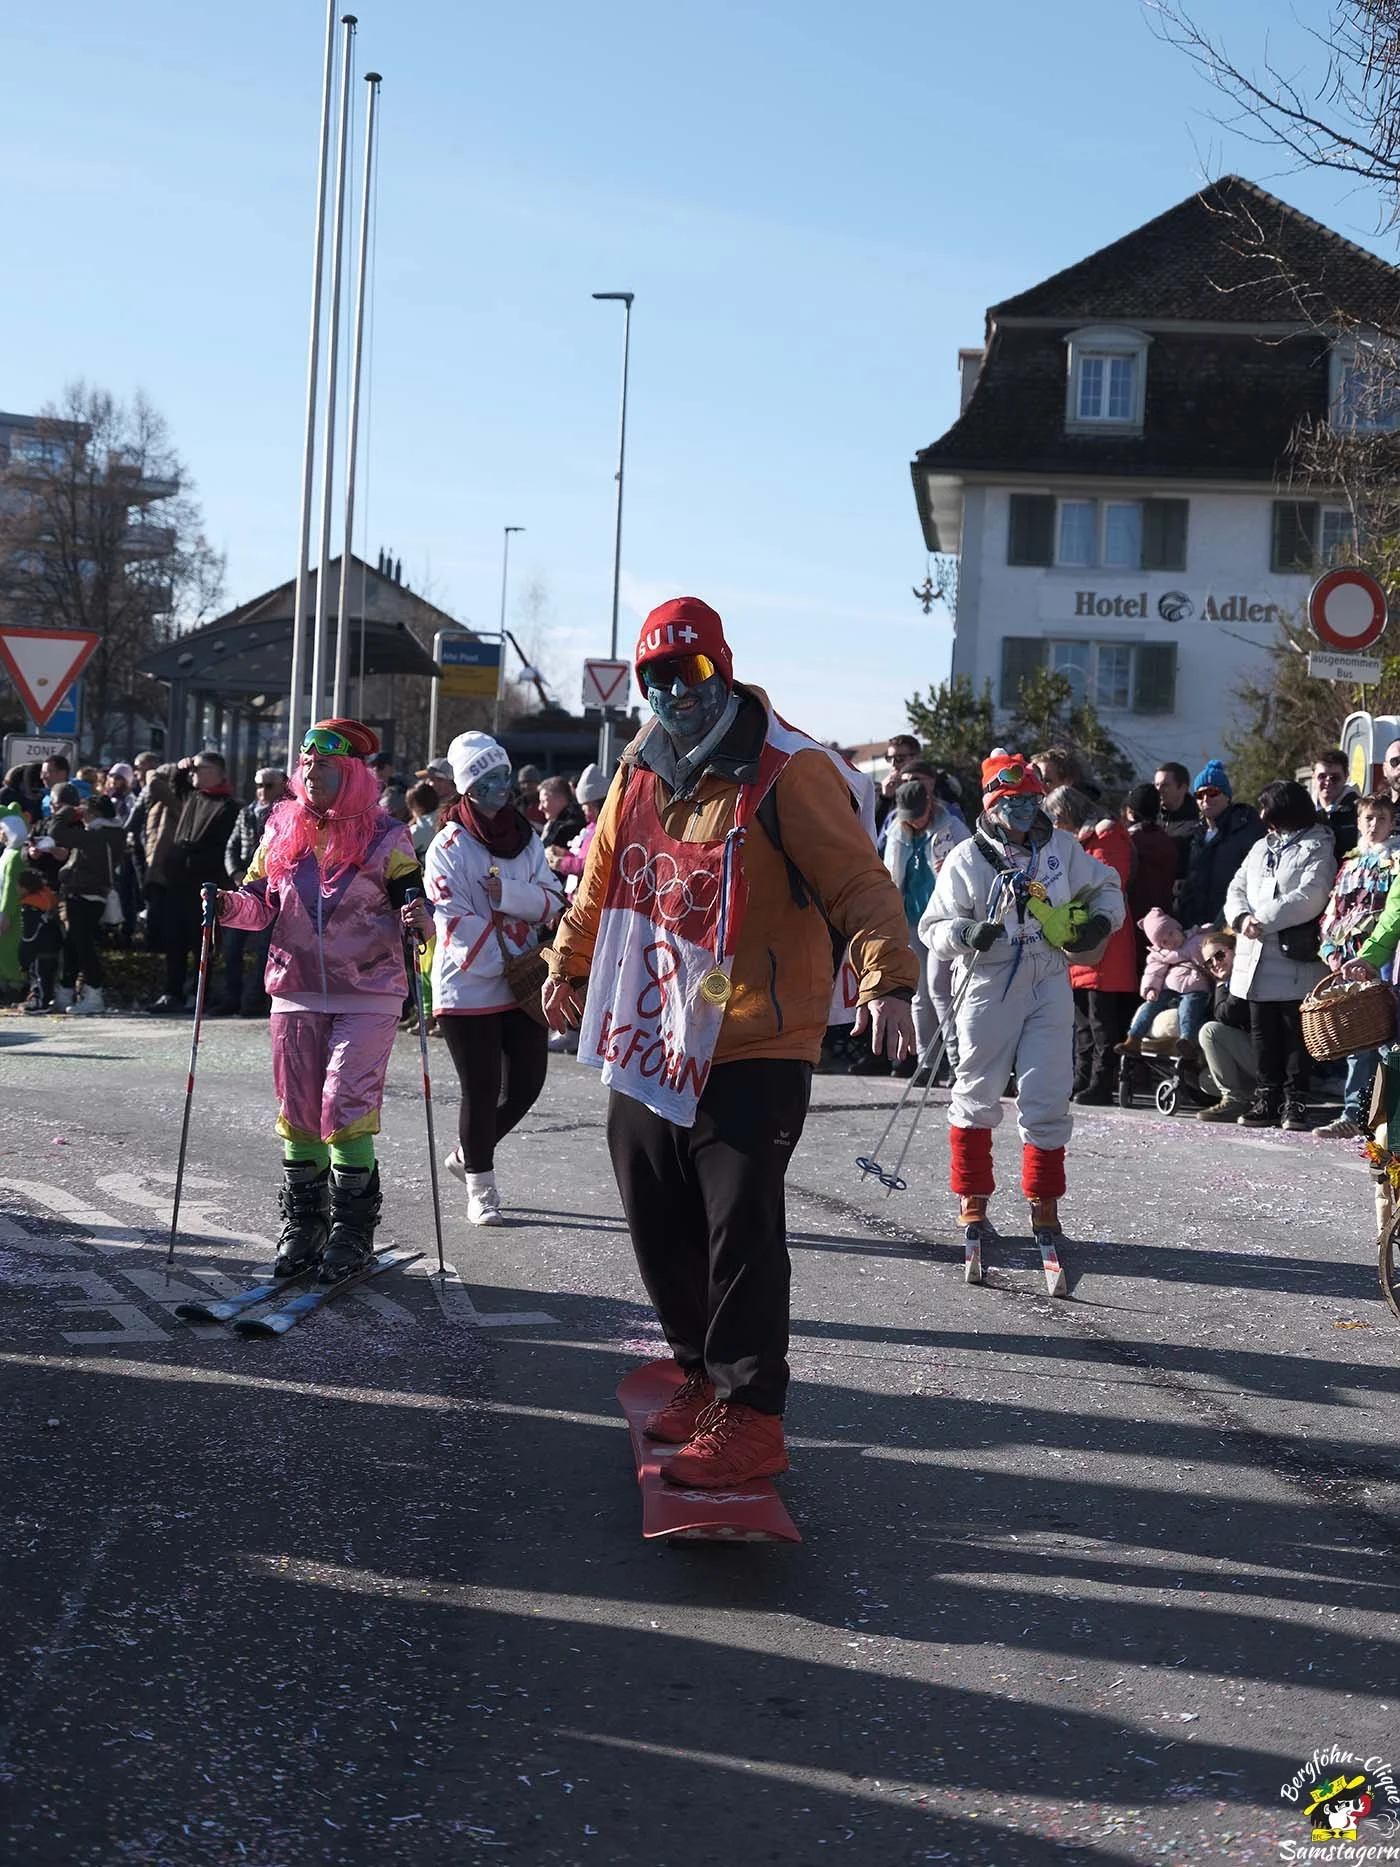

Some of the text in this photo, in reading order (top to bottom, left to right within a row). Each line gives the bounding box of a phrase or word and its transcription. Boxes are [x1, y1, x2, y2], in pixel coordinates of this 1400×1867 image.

[1074, 591, 1280, 623] Hotel Adler
[1312, 655, 1379, 669] ausgenommen
[1337, 668, 1353, 679] Bus
[26, 745, 57, 756] ZONE
